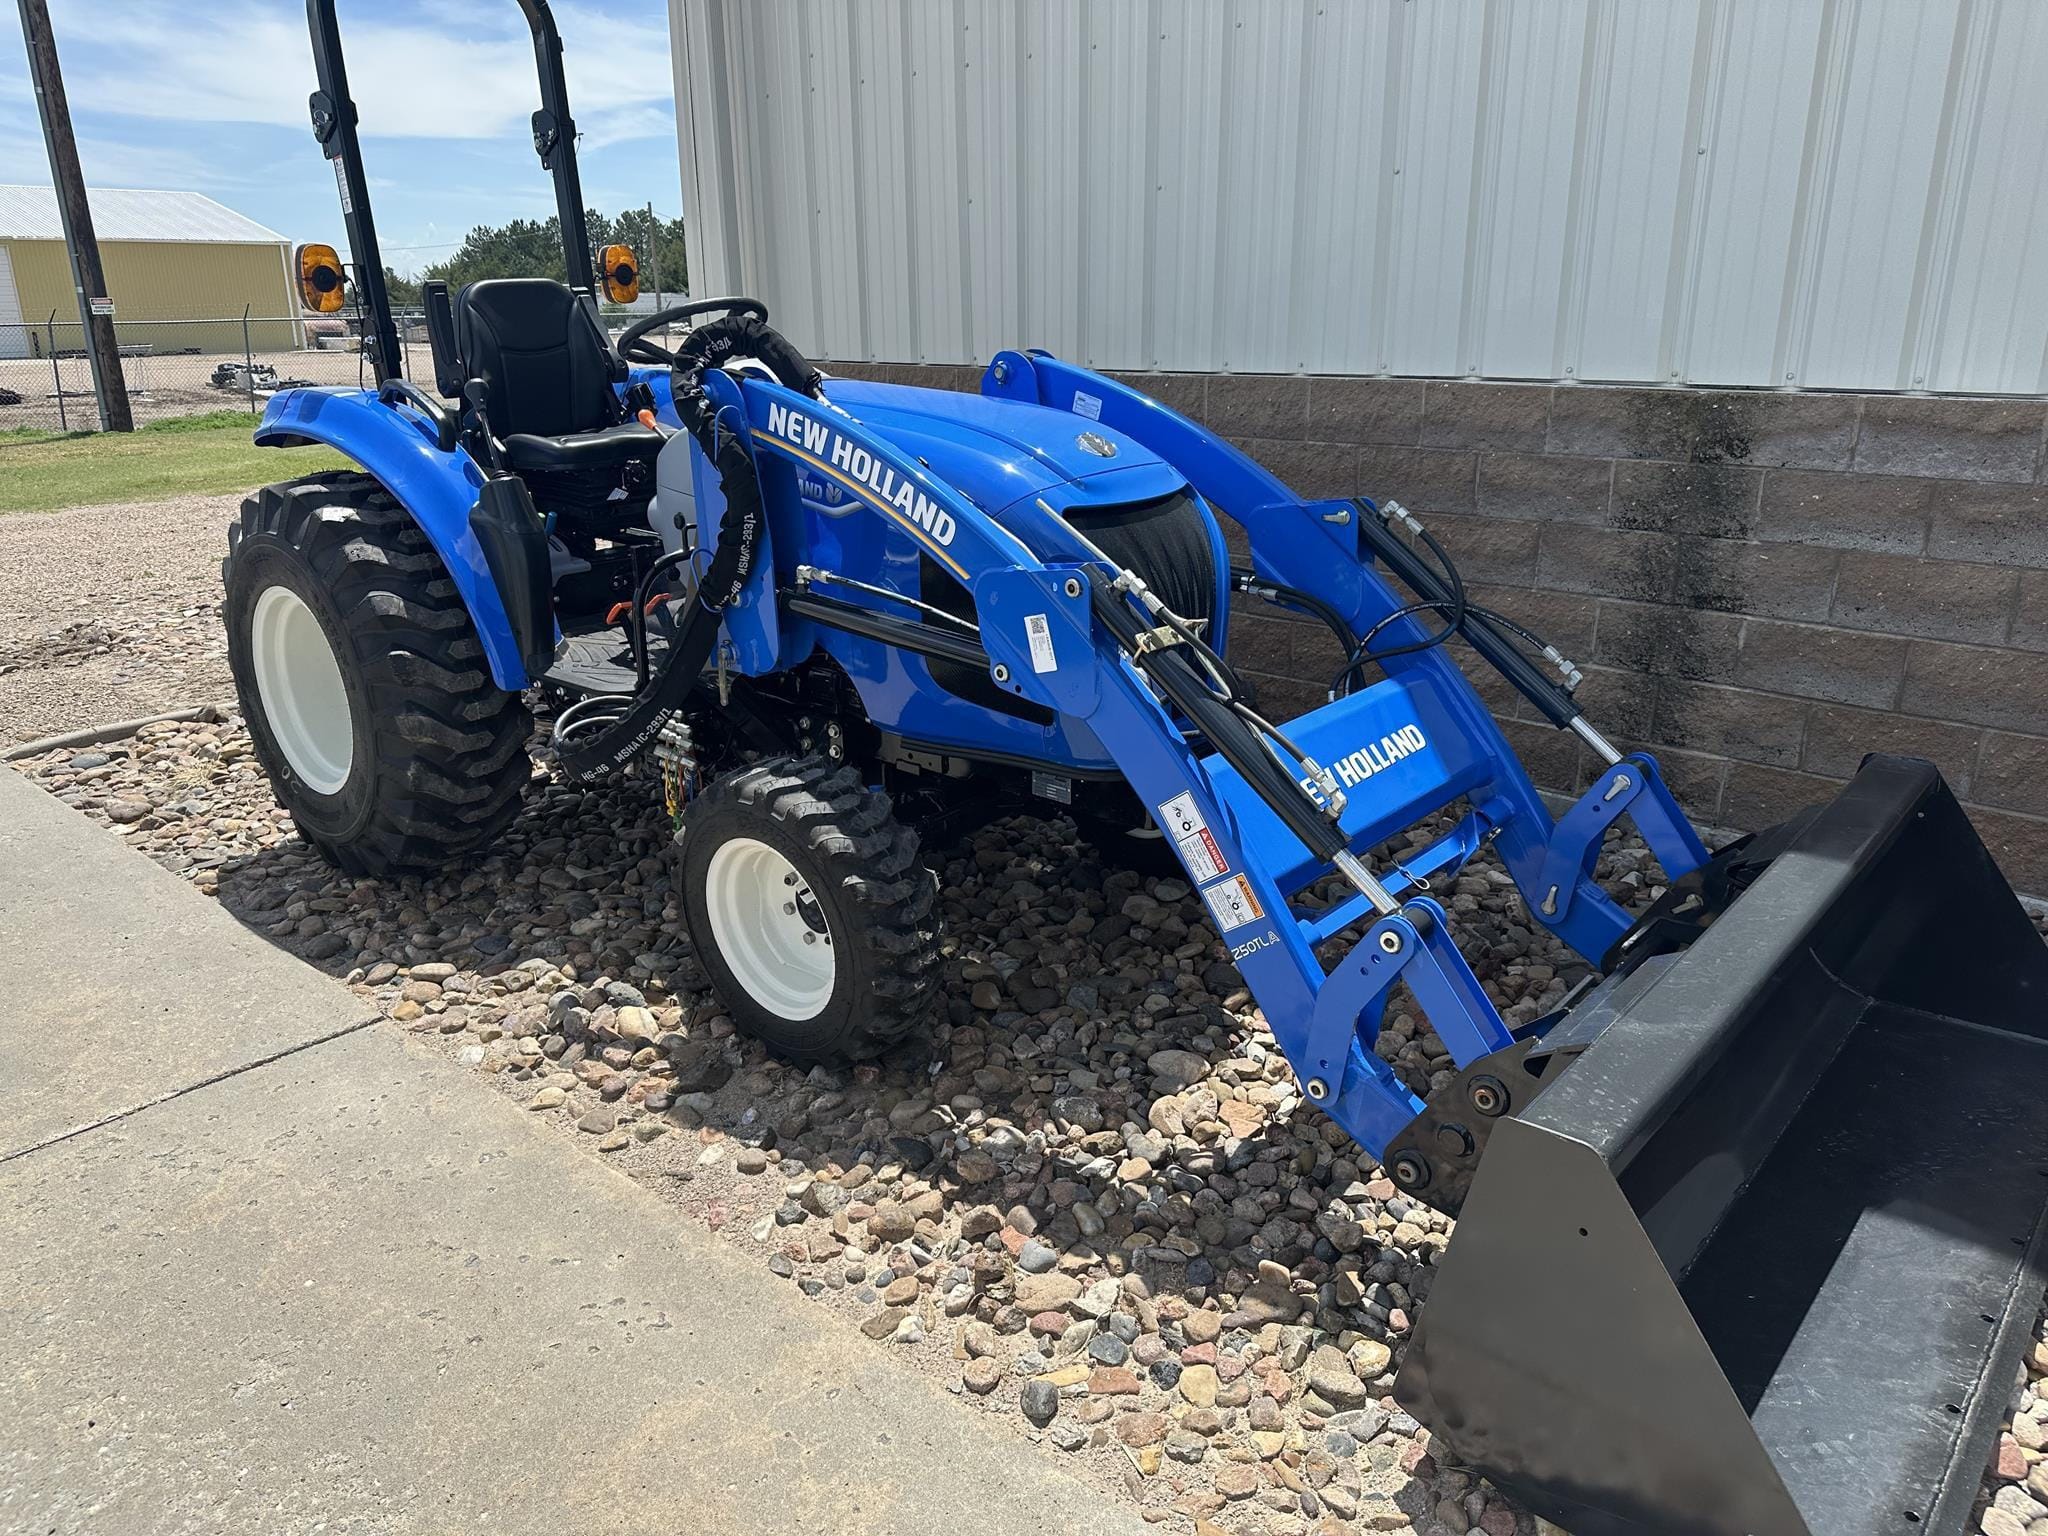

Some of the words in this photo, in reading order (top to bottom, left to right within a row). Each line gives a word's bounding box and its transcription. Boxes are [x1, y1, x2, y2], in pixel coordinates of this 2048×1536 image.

[768, 402, 829, 456] NEW
[831, 434, 957, 547] HOLLAND
[581, 763, 610, 781] HG-46
[613, 741, 640, 763] MSHA
[636, 707, 672, 744] IC-293/1
[1333, 723, 1427, 788] HOLLAND
[1206, 840, 1225, 871] DANGER
[1230, 931, 1281, 961] 250TLA
